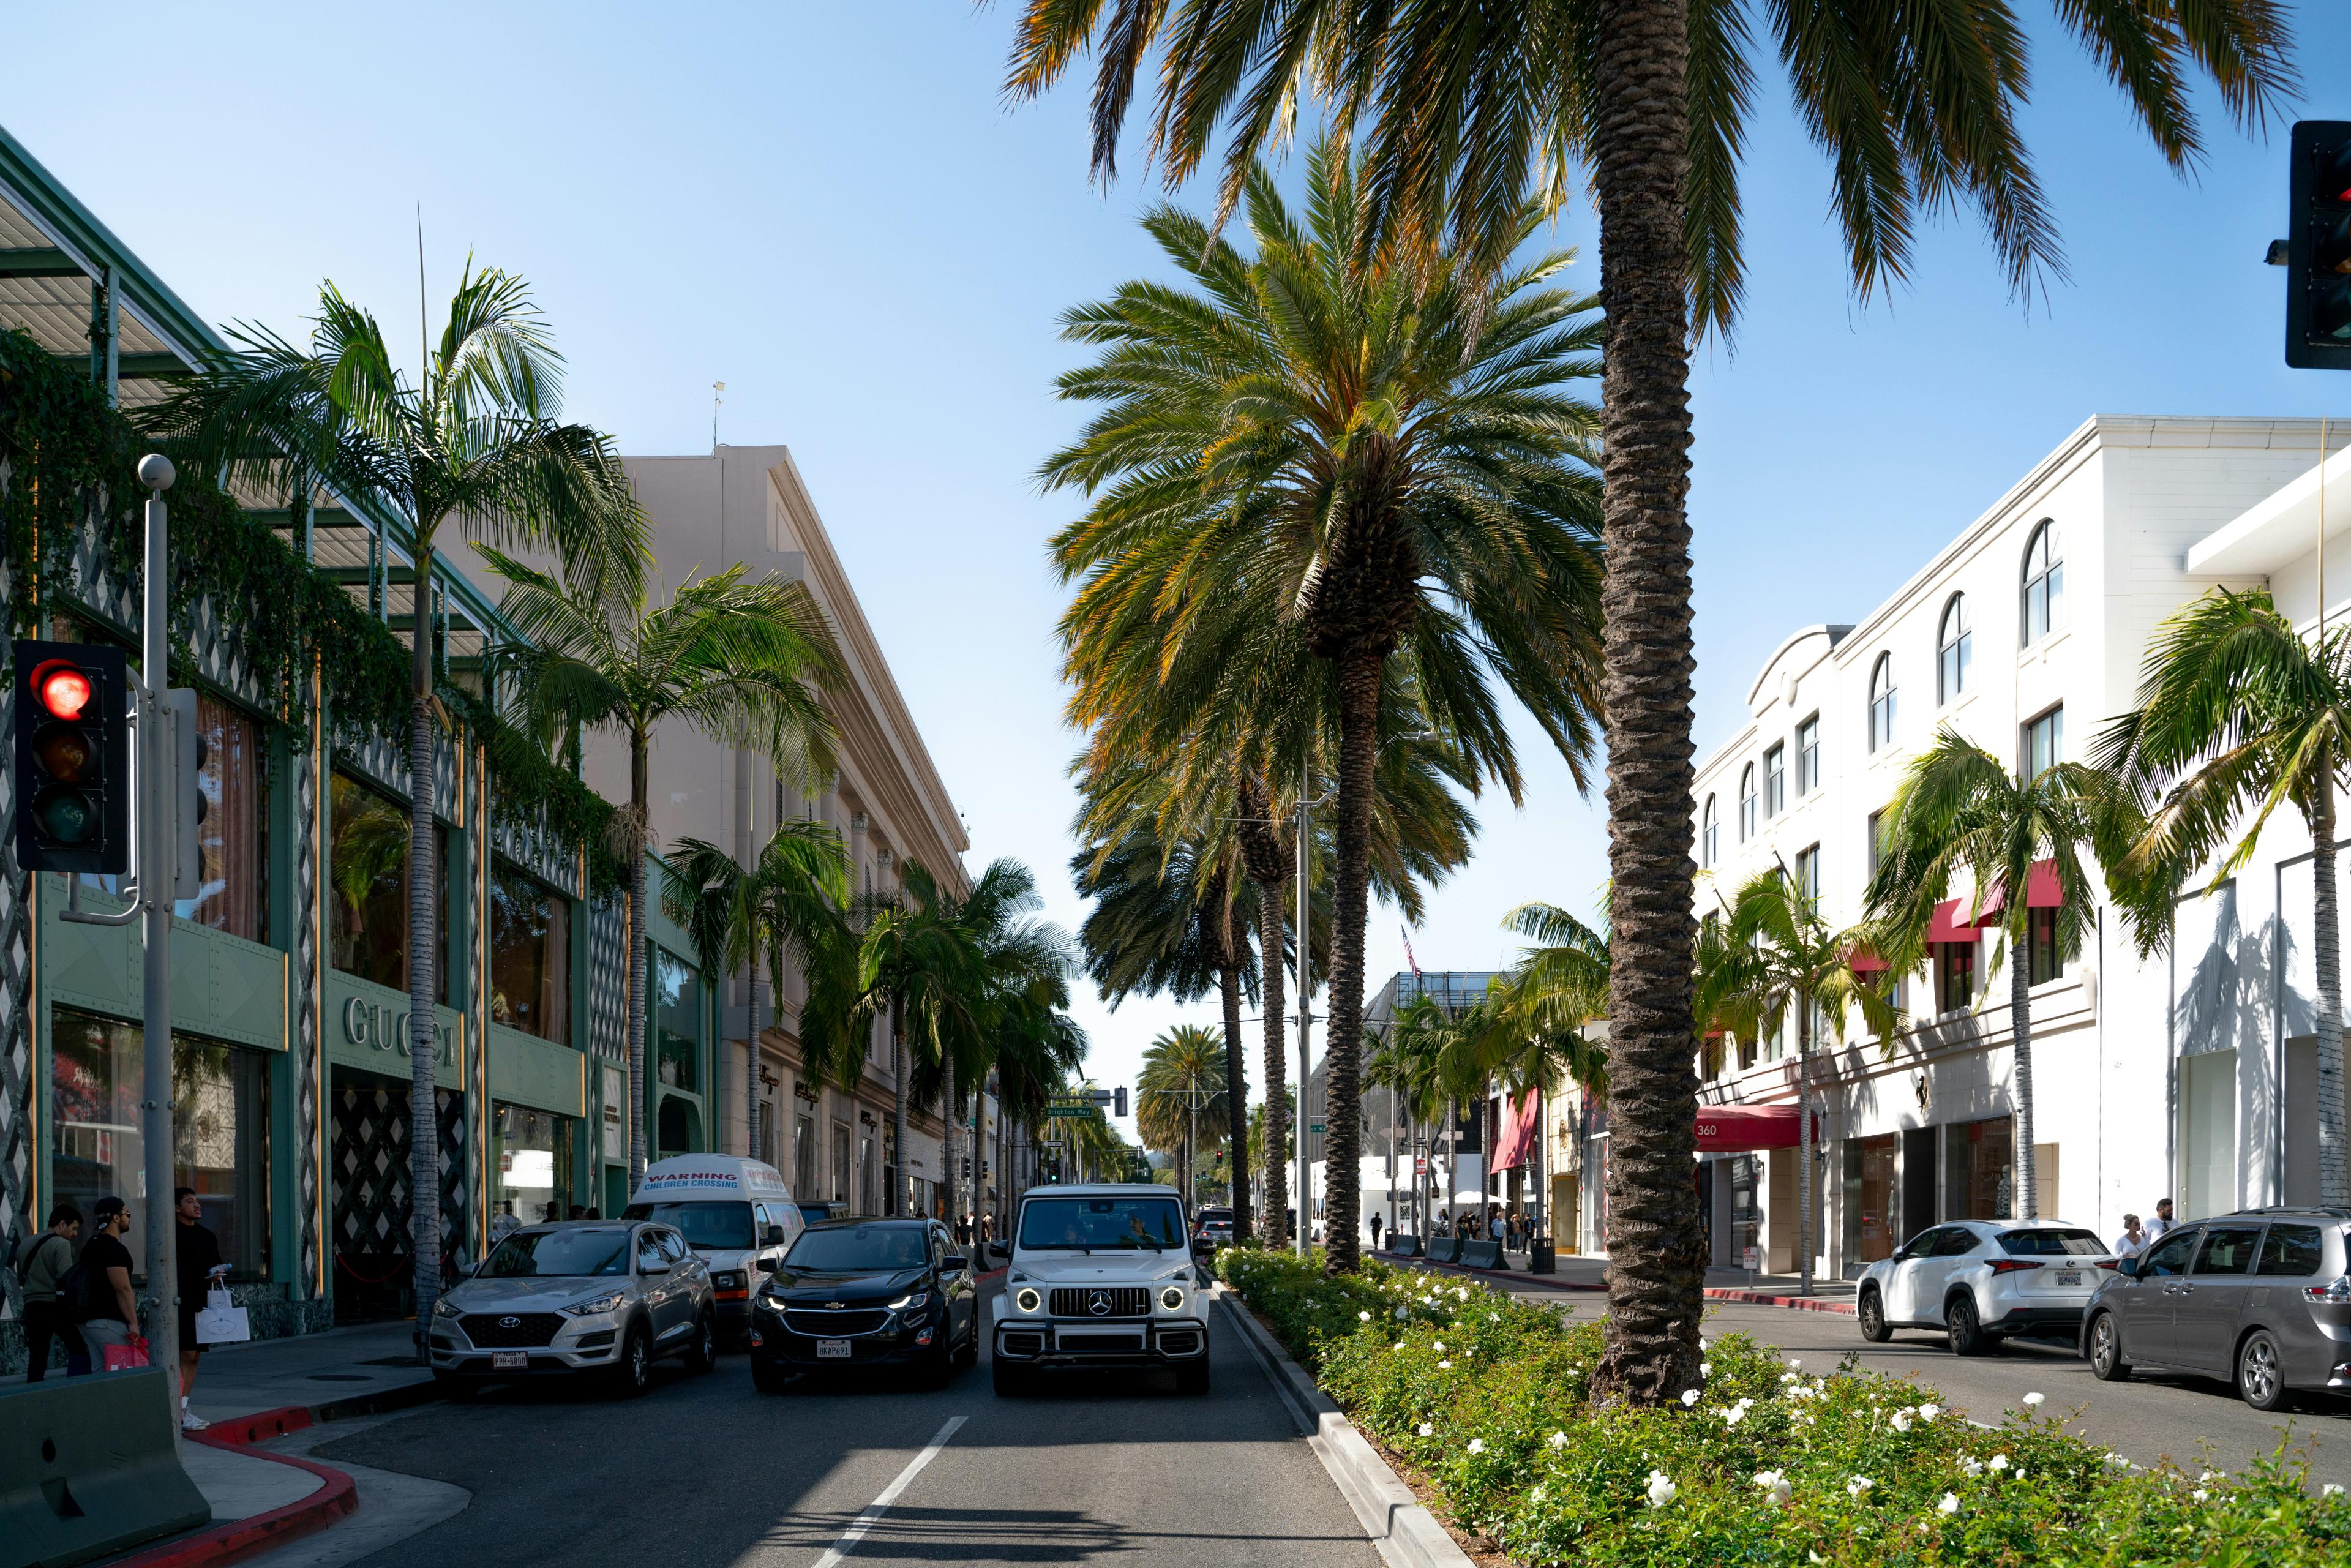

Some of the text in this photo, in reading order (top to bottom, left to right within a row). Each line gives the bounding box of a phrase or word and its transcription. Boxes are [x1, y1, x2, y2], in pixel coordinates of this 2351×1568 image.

[1698, 1125, 1716, 1135] 360
[648, 1173, 737, 1182] WARNING
[645, 1180, 738, 1191] CHILDREN CROSSING
[819, 1347, 849, 1356] 8KAP691
